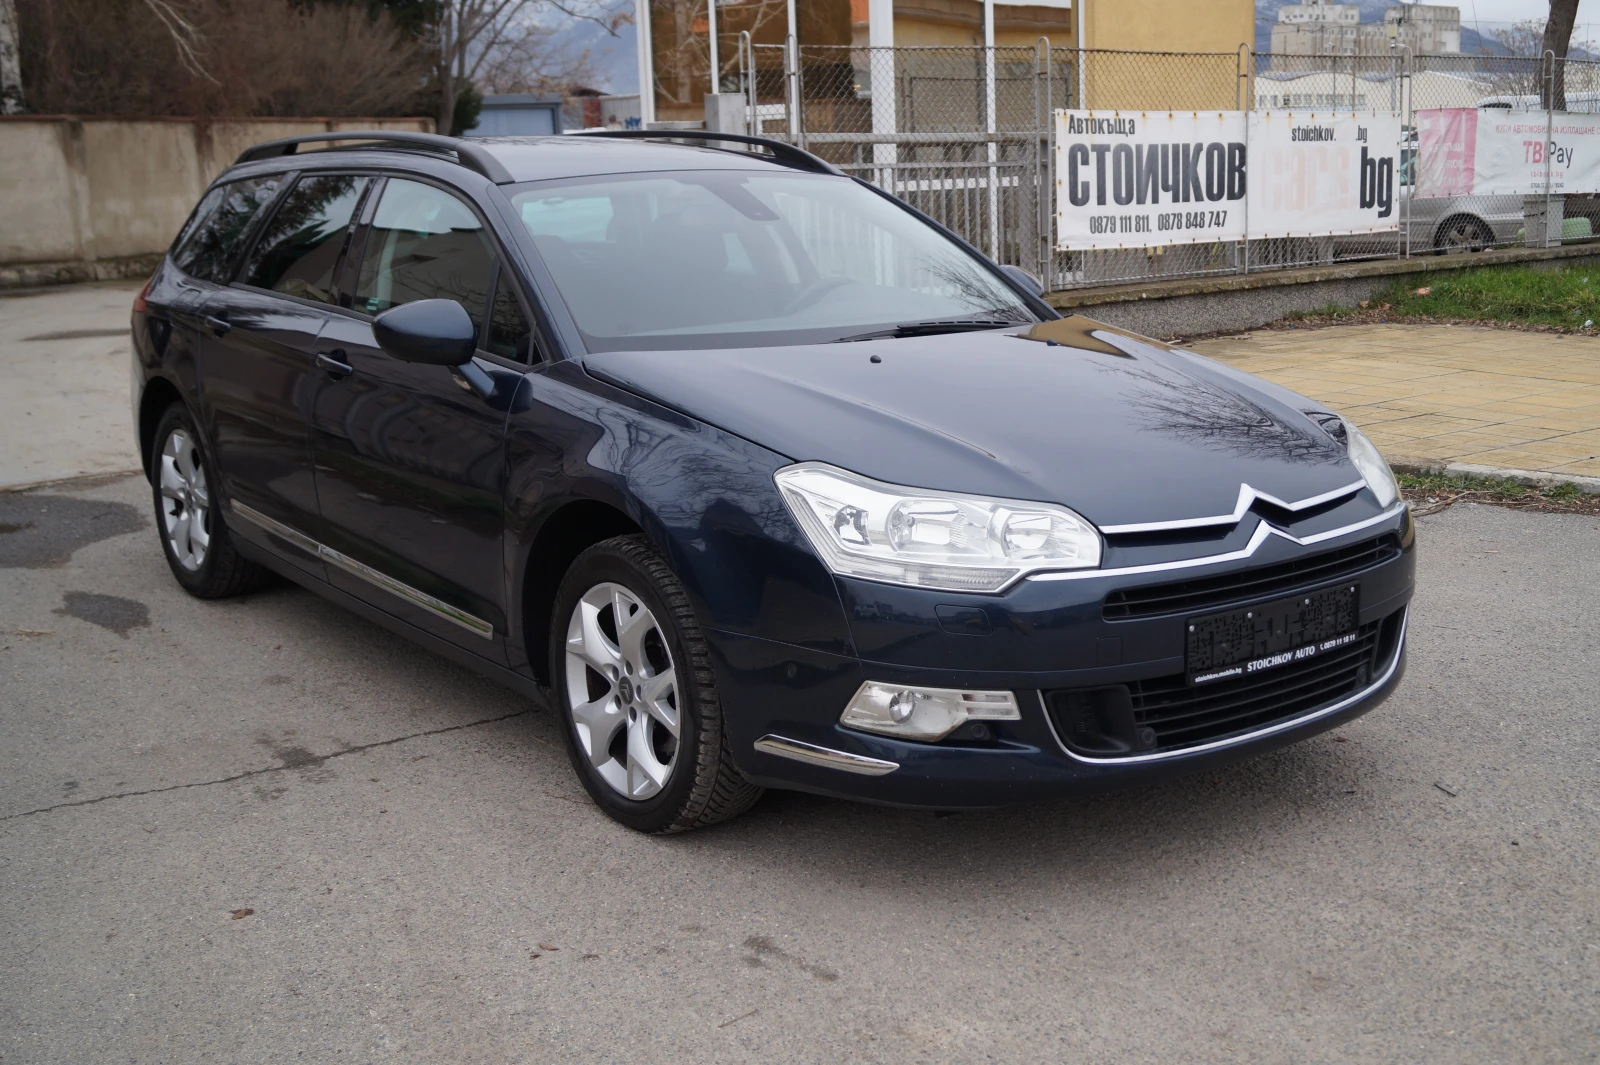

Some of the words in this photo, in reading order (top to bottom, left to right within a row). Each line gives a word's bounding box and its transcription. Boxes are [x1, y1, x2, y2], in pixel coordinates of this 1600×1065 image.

[1068, 114, 1136, 137] Автокъща
[1068, 142, 1247, 207] СТОИЧКОВ
[1089, 215, 1117, 234] 0879
[1119, 215, 1132, 233] 111
[1157, 212, 1183, 231] 0878
[1185, 211, 1206, 230] 848
[1208, 210, 1228, 228] 747
[1247, 652, 1293, 672] STOICHKOV
[1295, 645, 1315, 660] AUTO
[1350, 633, 1356, 641] 11
